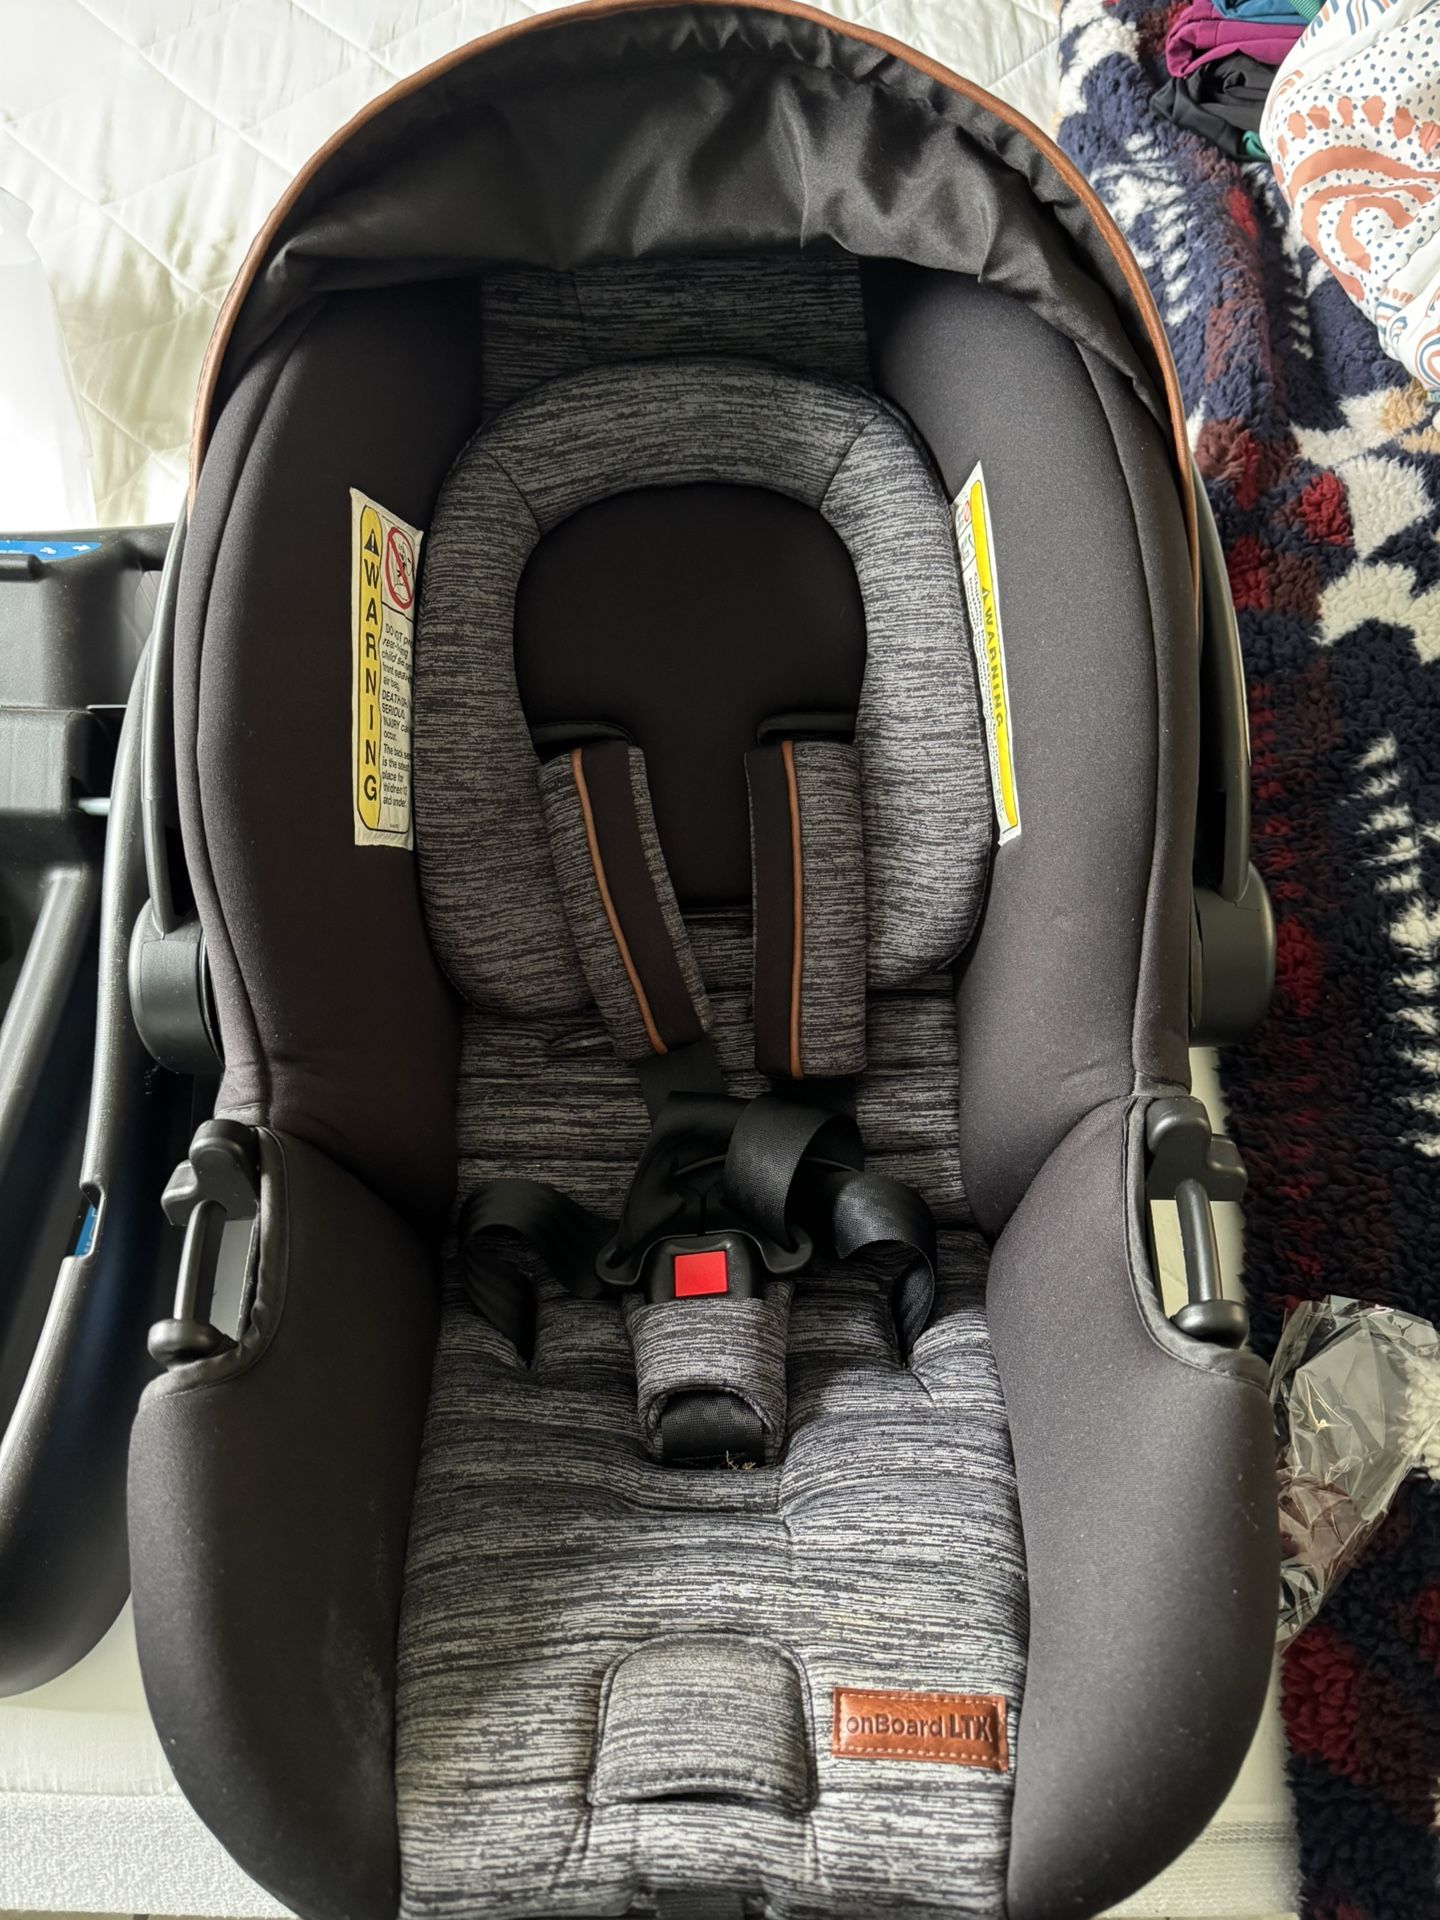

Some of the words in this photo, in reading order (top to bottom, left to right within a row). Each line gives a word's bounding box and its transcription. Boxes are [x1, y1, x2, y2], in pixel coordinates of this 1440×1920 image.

[363, 558, 380, 801] WARNING
[984, 606, 1004, 728] WARNING
[382, 756, 388, 767] is
[384, 743, 393, 756] The
[846, 1713, 946, 1739] onBoard
[949, 1713, 993, 1742] LTX
